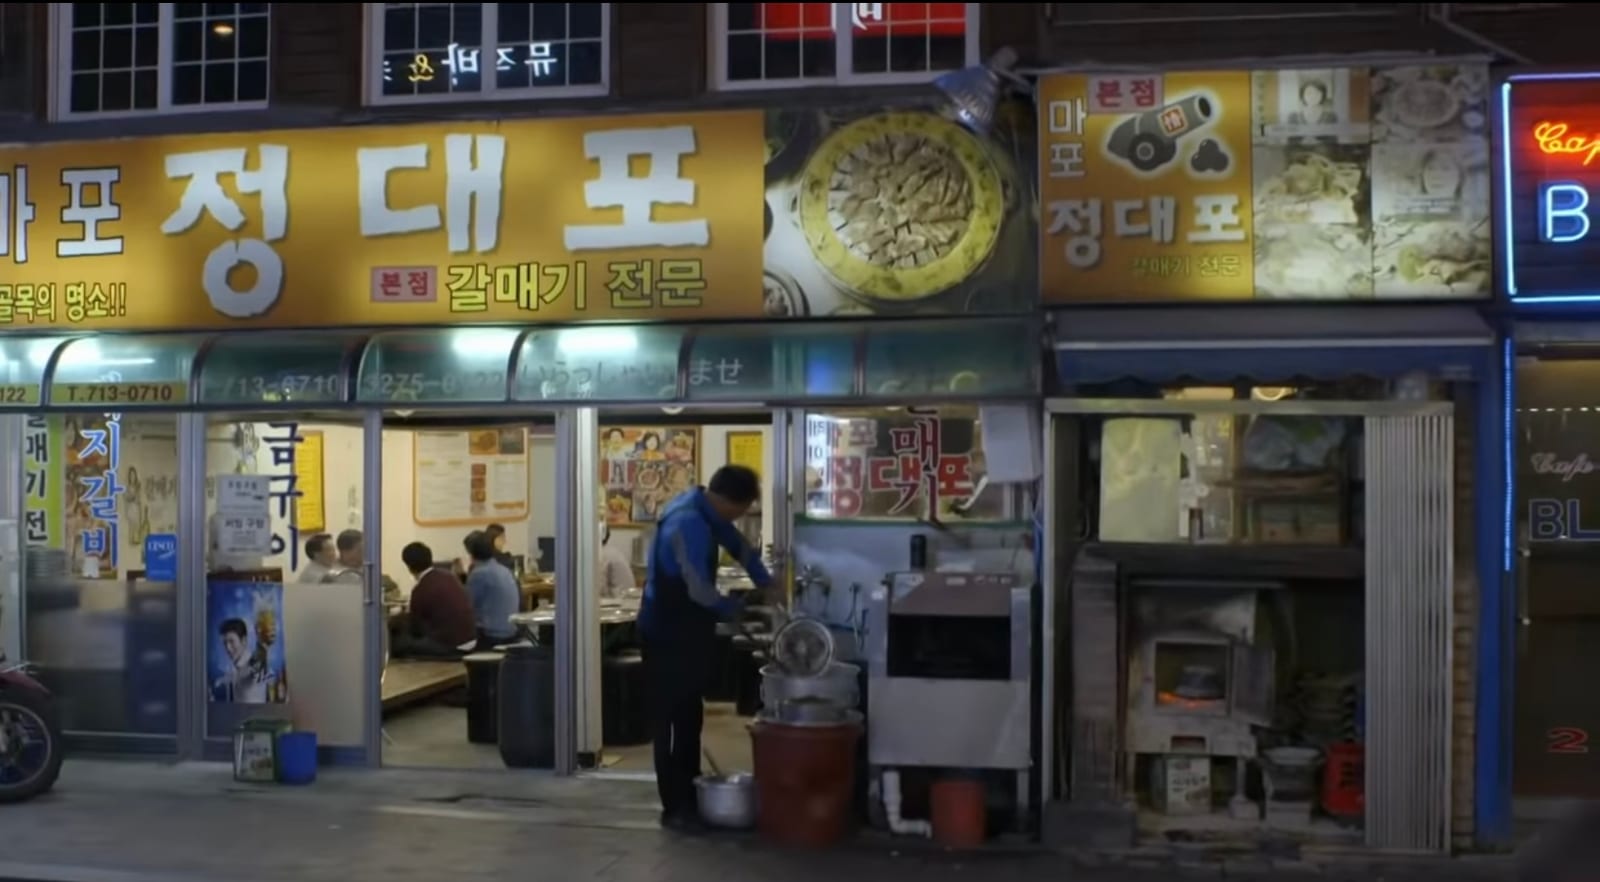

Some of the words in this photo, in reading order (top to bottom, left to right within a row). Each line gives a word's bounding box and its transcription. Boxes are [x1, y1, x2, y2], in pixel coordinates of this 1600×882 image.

[1096, 79, 1156, 108] 본점
[1048, 97, 1088, 178] 마포
[160, 125, 710, 318] 정대포
[1047, 195, 1246, 268] 정대포
[380, 271, 429, 297] 본점
[446, 262, 588, 313] 갈매기
[606, 258, 707, 309] 전문
[1198, 254, 1241, 278] 전문
[64, 282, 127, 322] 명소!!
[67, 384, 173, 401] T.713-0710
[78, 413, 126, 568] 지갈비
